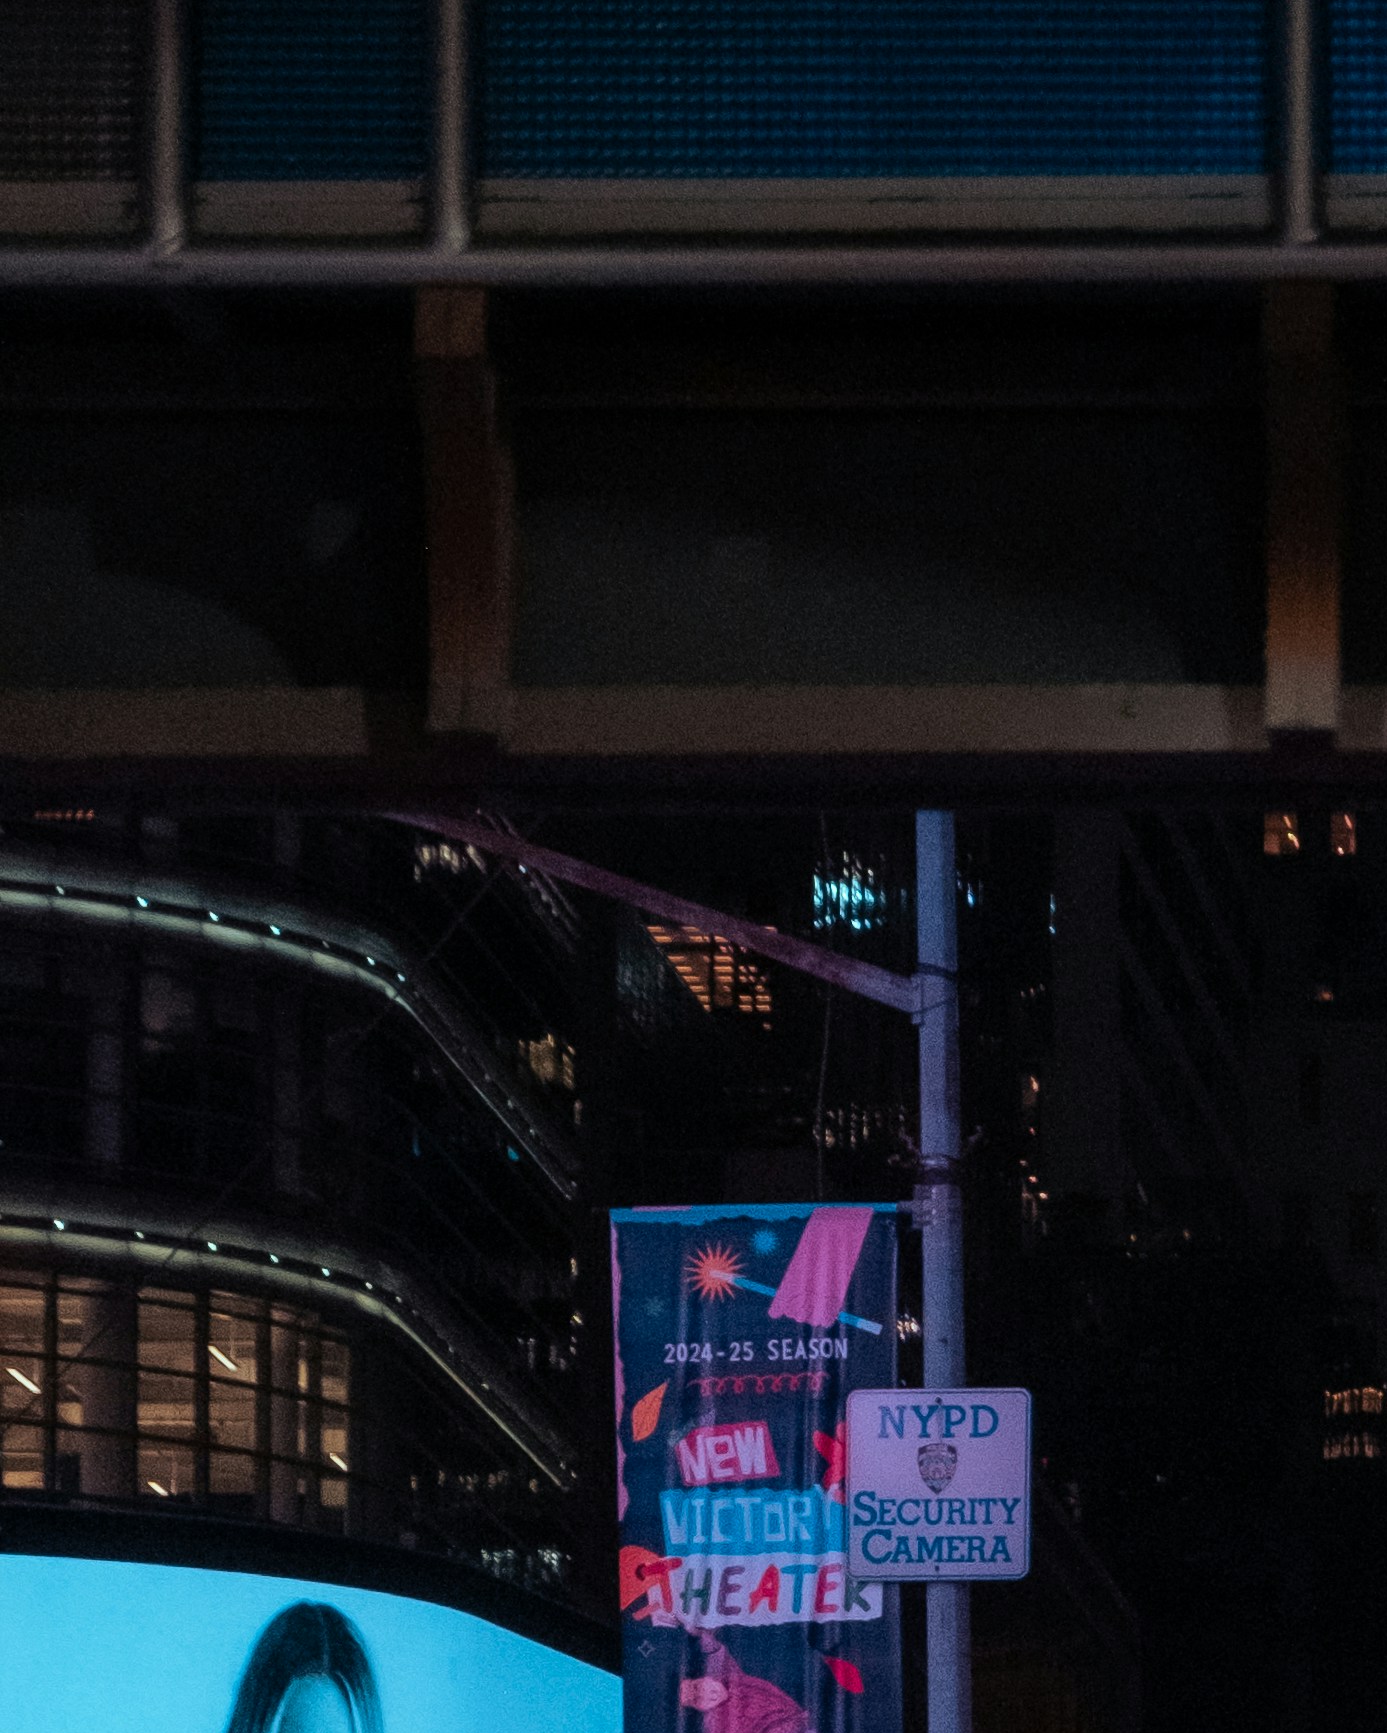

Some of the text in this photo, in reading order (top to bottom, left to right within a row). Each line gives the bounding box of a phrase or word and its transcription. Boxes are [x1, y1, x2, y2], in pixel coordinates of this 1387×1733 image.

[663, 1338, 849, 1364] 2024-25 SEASON
[878, 1404, 999, 1439] NYPD
[665, 1484, 841, 1545] VICTORY
[853, 1490, 1021, 1527] SECURITY
[862, 1529, 1012, 1564] CAMERA
